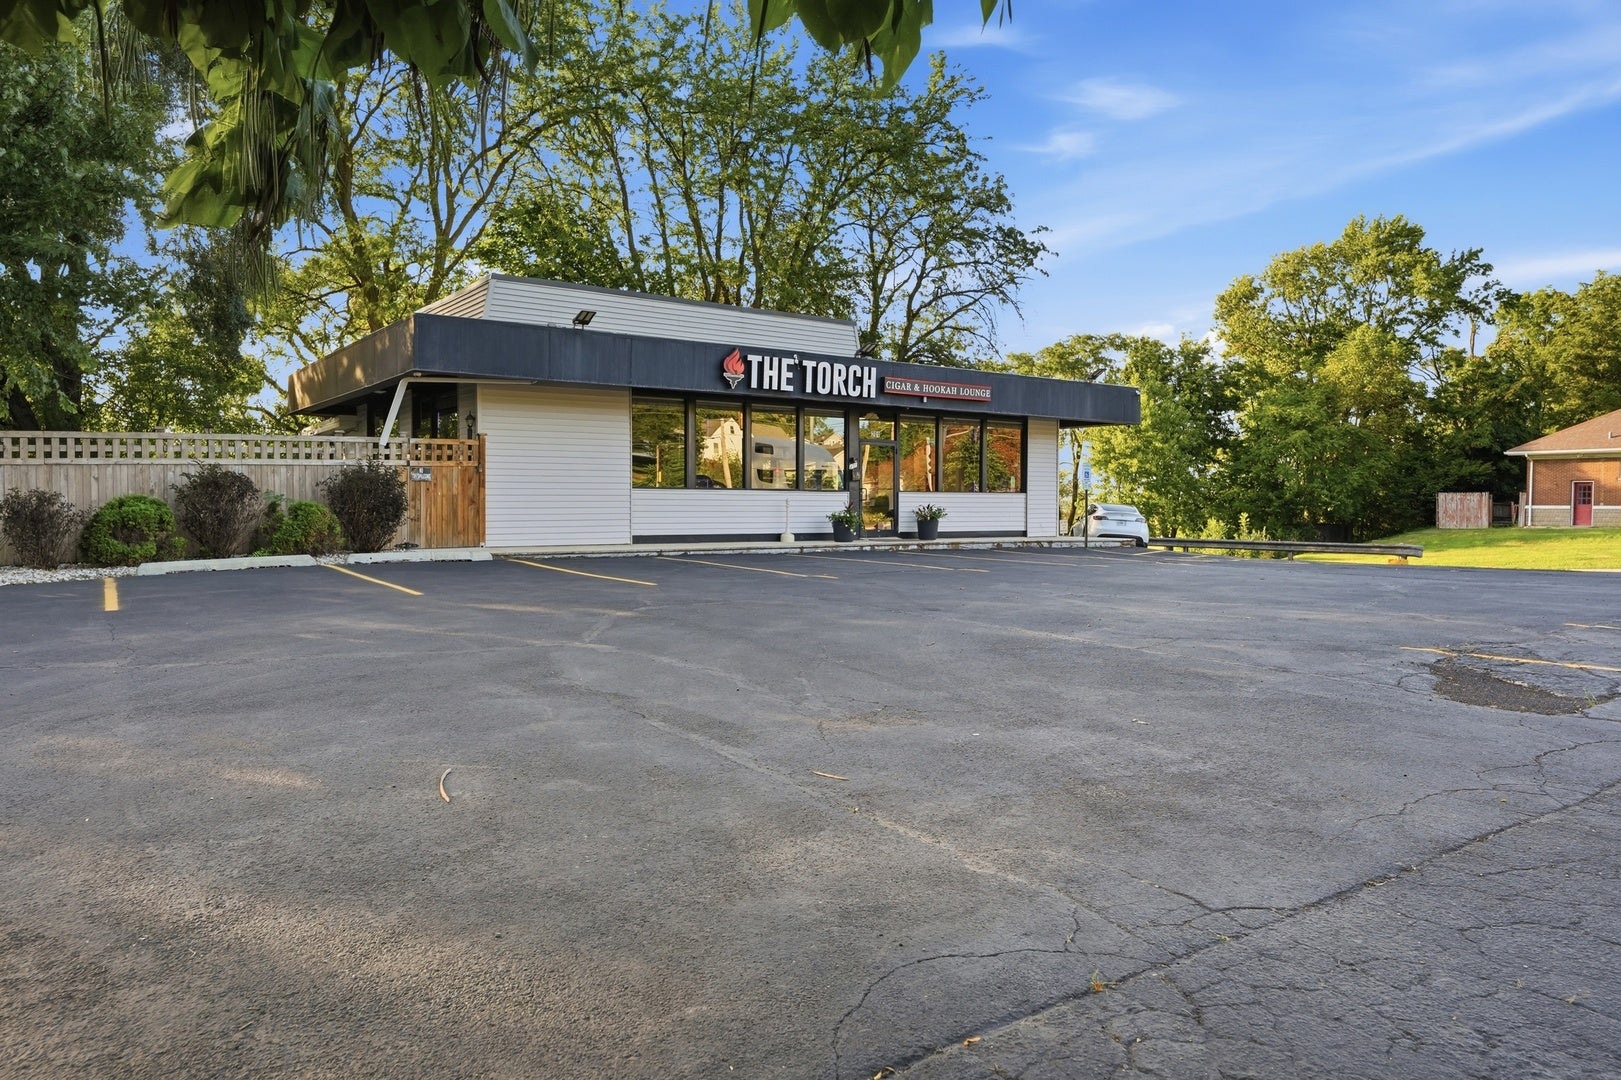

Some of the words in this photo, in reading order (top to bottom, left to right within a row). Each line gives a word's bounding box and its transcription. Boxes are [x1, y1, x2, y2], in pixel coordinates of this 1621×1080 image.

[747, 354, 794, 391] THE
[802, 360, 877, 398] TORCH
[885, 380, 912, 391] CIGAR
[913, 383, 921, 392] &
[923, 384, 957, 395] HOOKAH
[960, 387, 991, 398] LOUNGE
